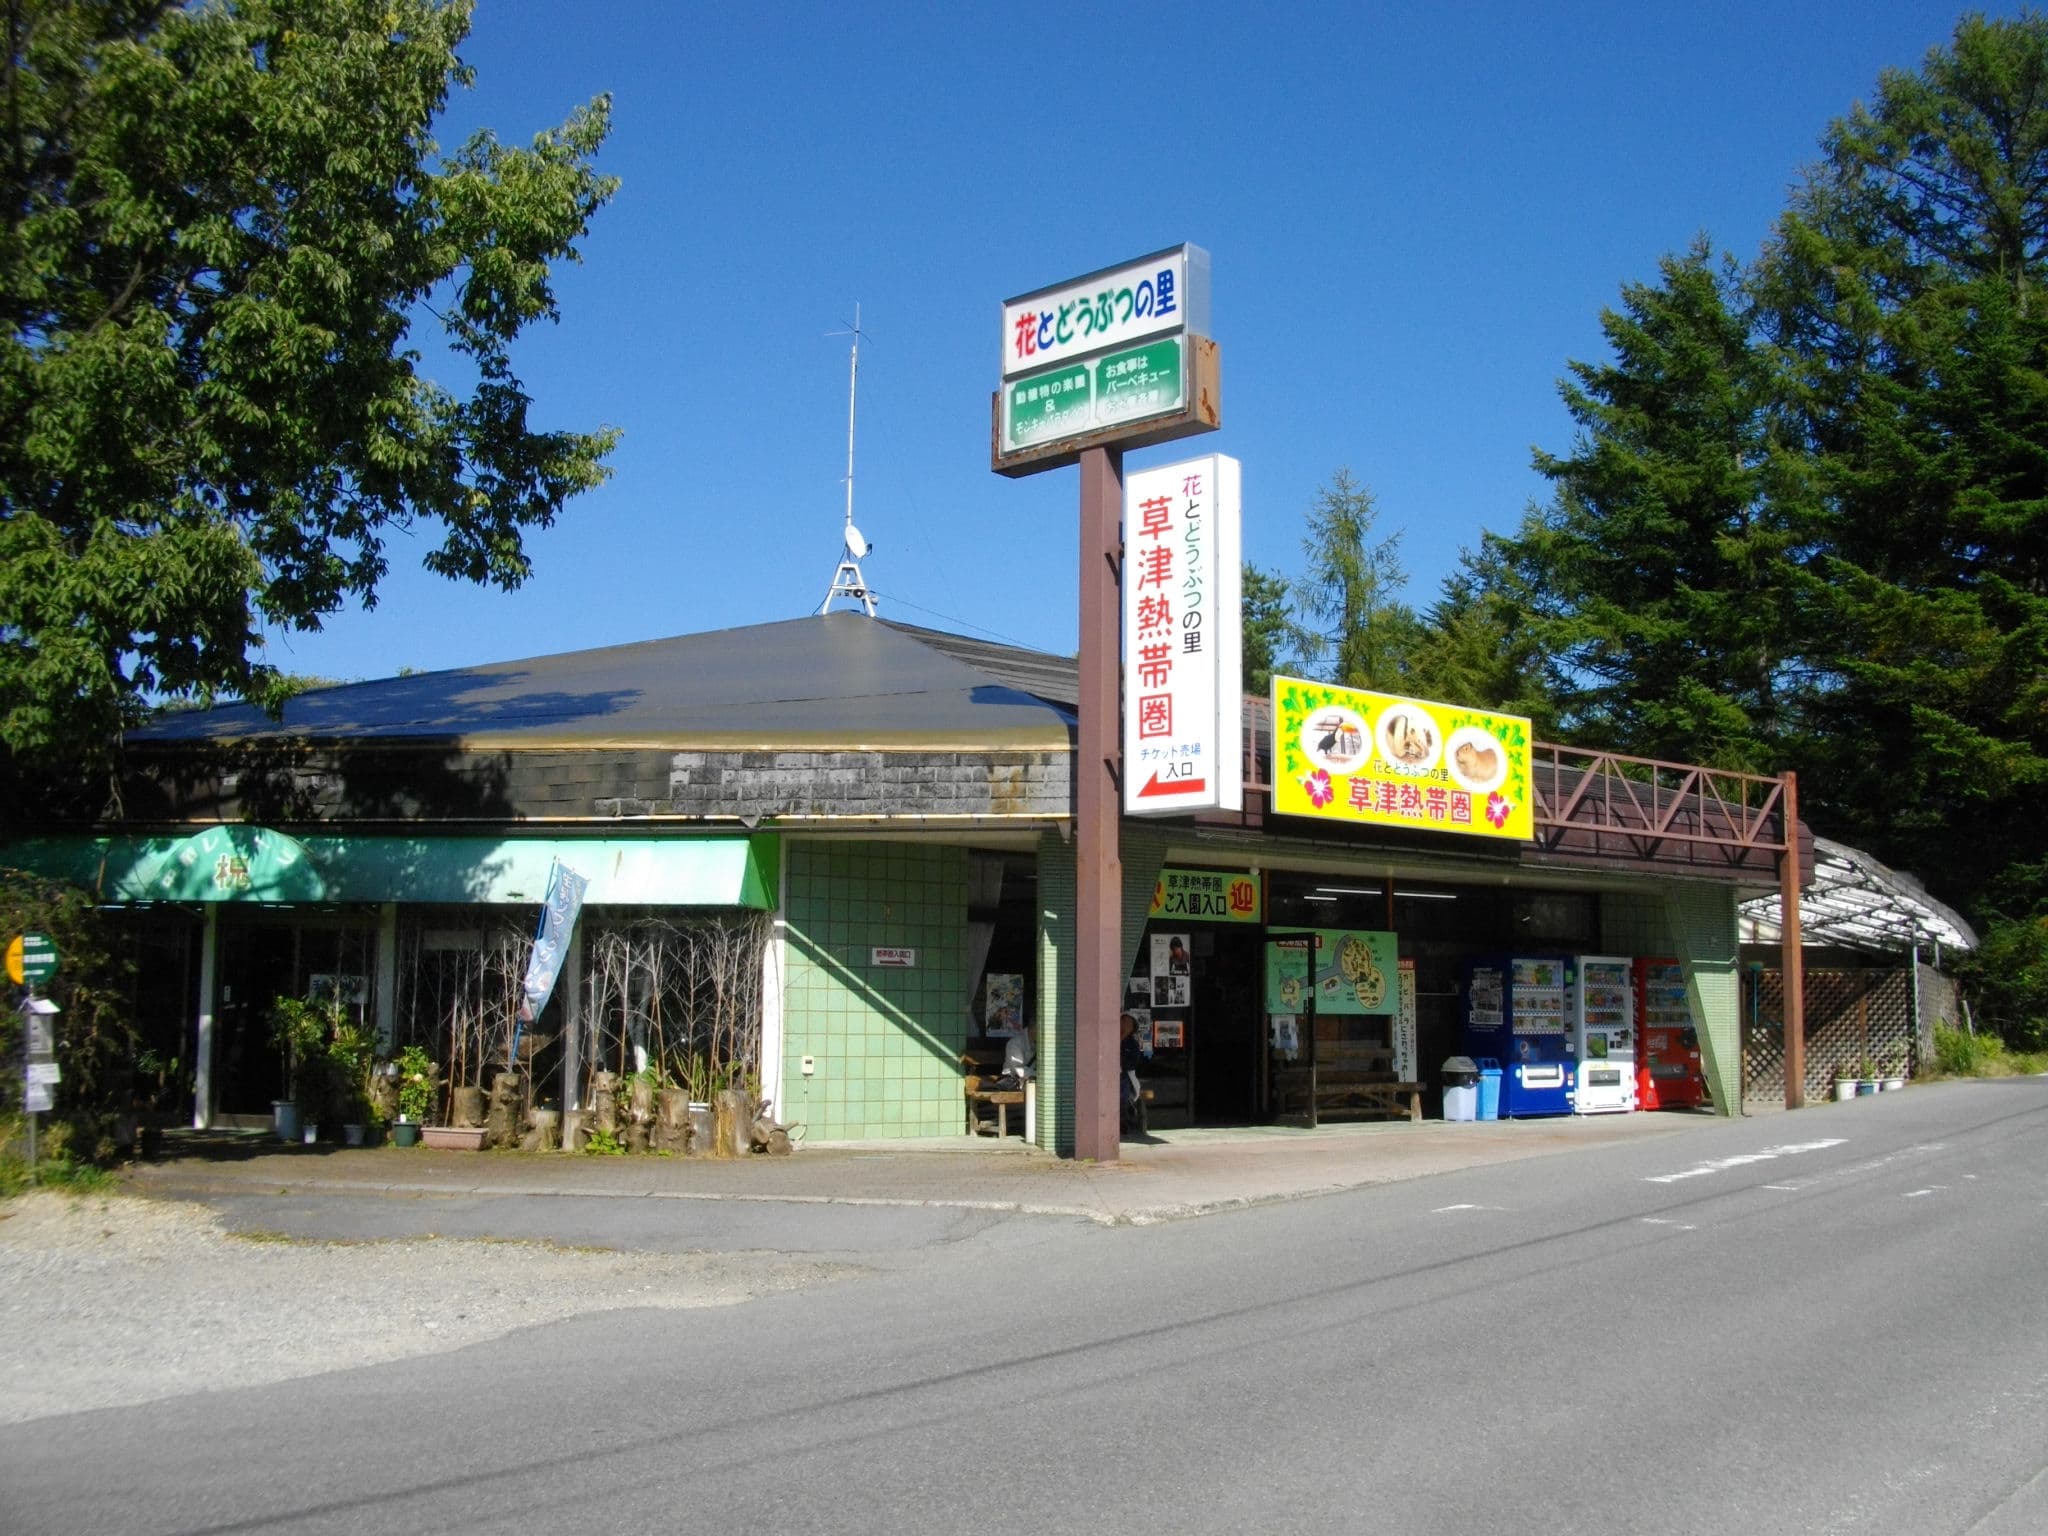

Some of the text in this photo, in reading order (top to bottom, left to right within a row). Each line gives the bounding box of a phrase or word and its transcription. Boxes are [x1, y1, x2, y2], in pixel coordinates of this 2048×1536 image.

[1015, 269, 1177, 358] 花とどうぶつの里
[1106, 370, 1170, 394] バーベキュー
[1182, 475, 1203, 655] 花とどうぶつの里
[1137, 496, 1173, 740] 草津熱帯圏
[1141, 743, 1201, 760] チケット売場
[1166, 762, 1193, 779] 入口
[1348, 777, 1472, 824] 草津熱帯圏
[1168, 874, 1222, 893] 草津熱帯圏
[1230, 882, 1254, 912] 迎
[1165, 893, 1227, 916] ご入園入口
